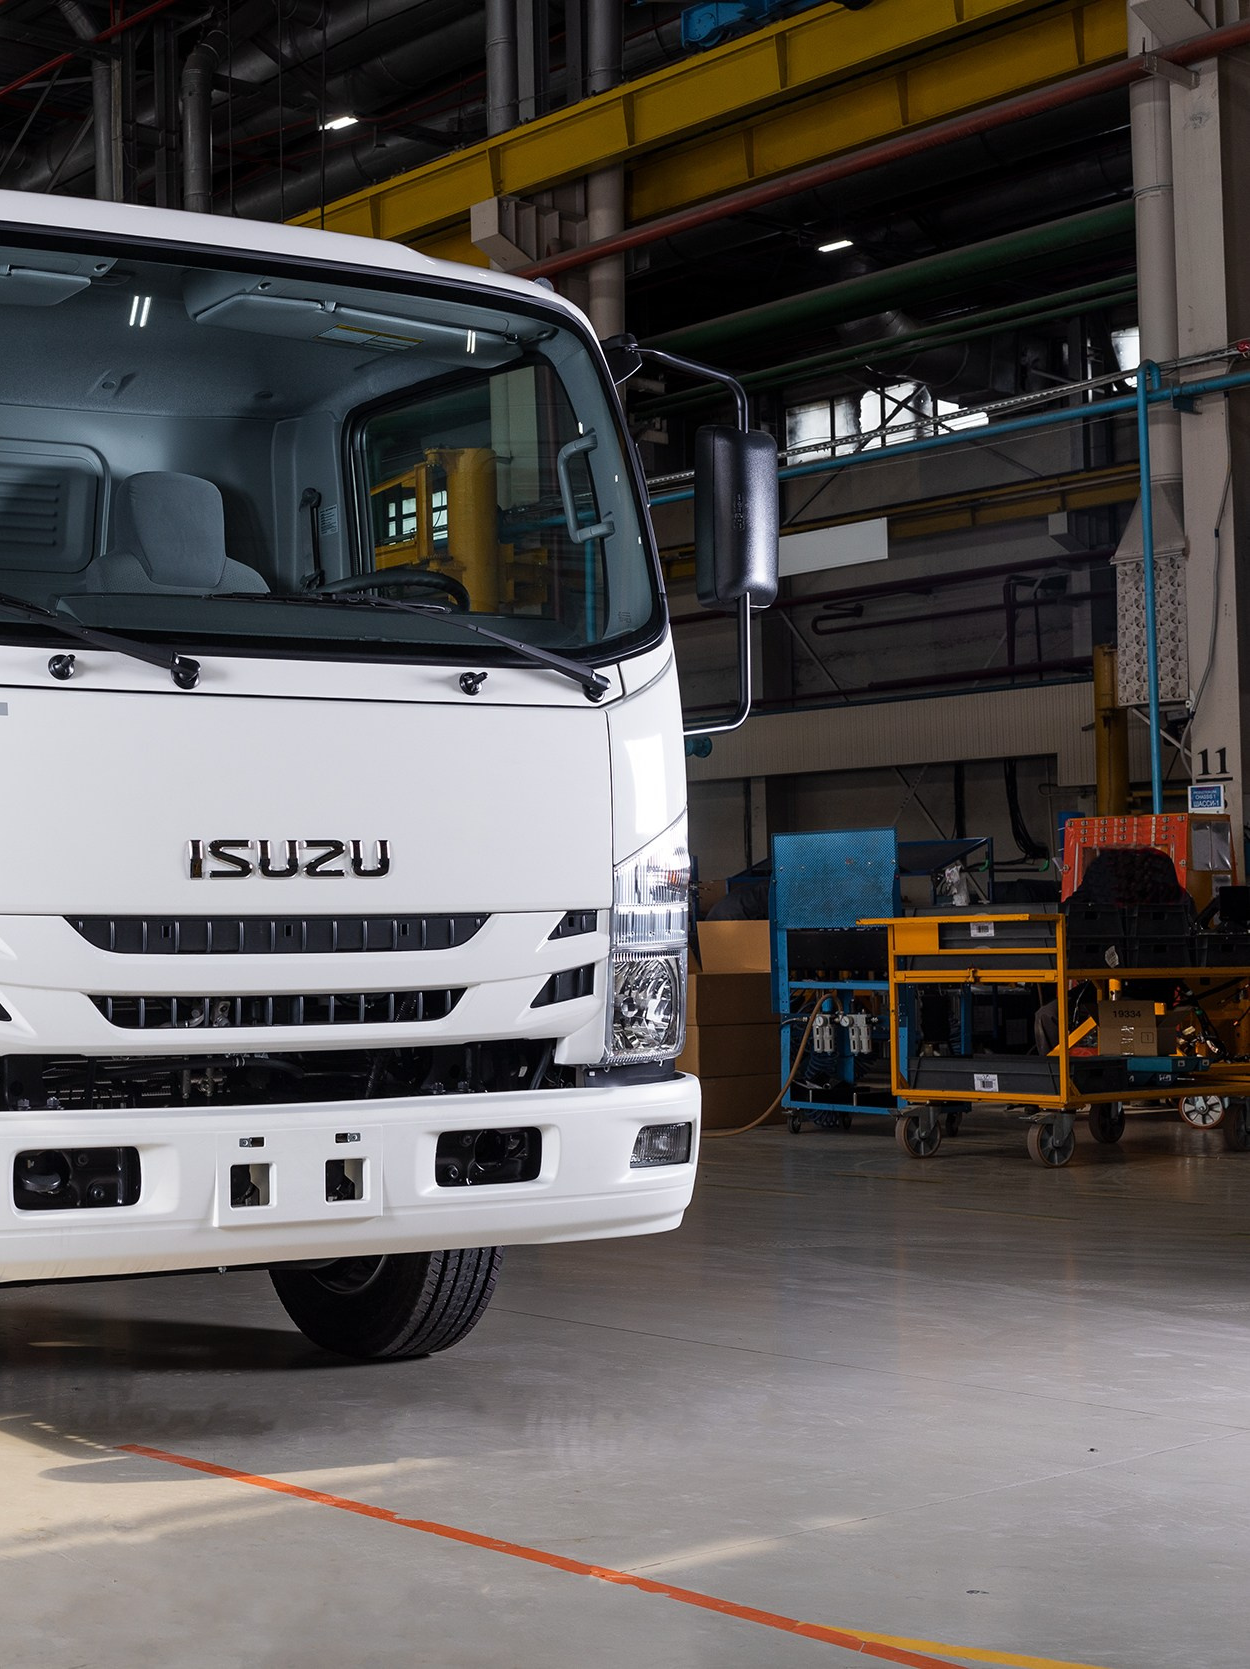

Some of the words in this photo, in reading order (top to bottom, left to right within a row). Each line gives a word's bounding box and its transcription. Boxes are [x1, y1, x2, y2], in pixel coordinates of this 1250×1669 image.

[1197, 747, 1230, 776] 11
[189, 839, 392, 880] ISUZU
[1113, 1010, 1141, 1018] 19334
